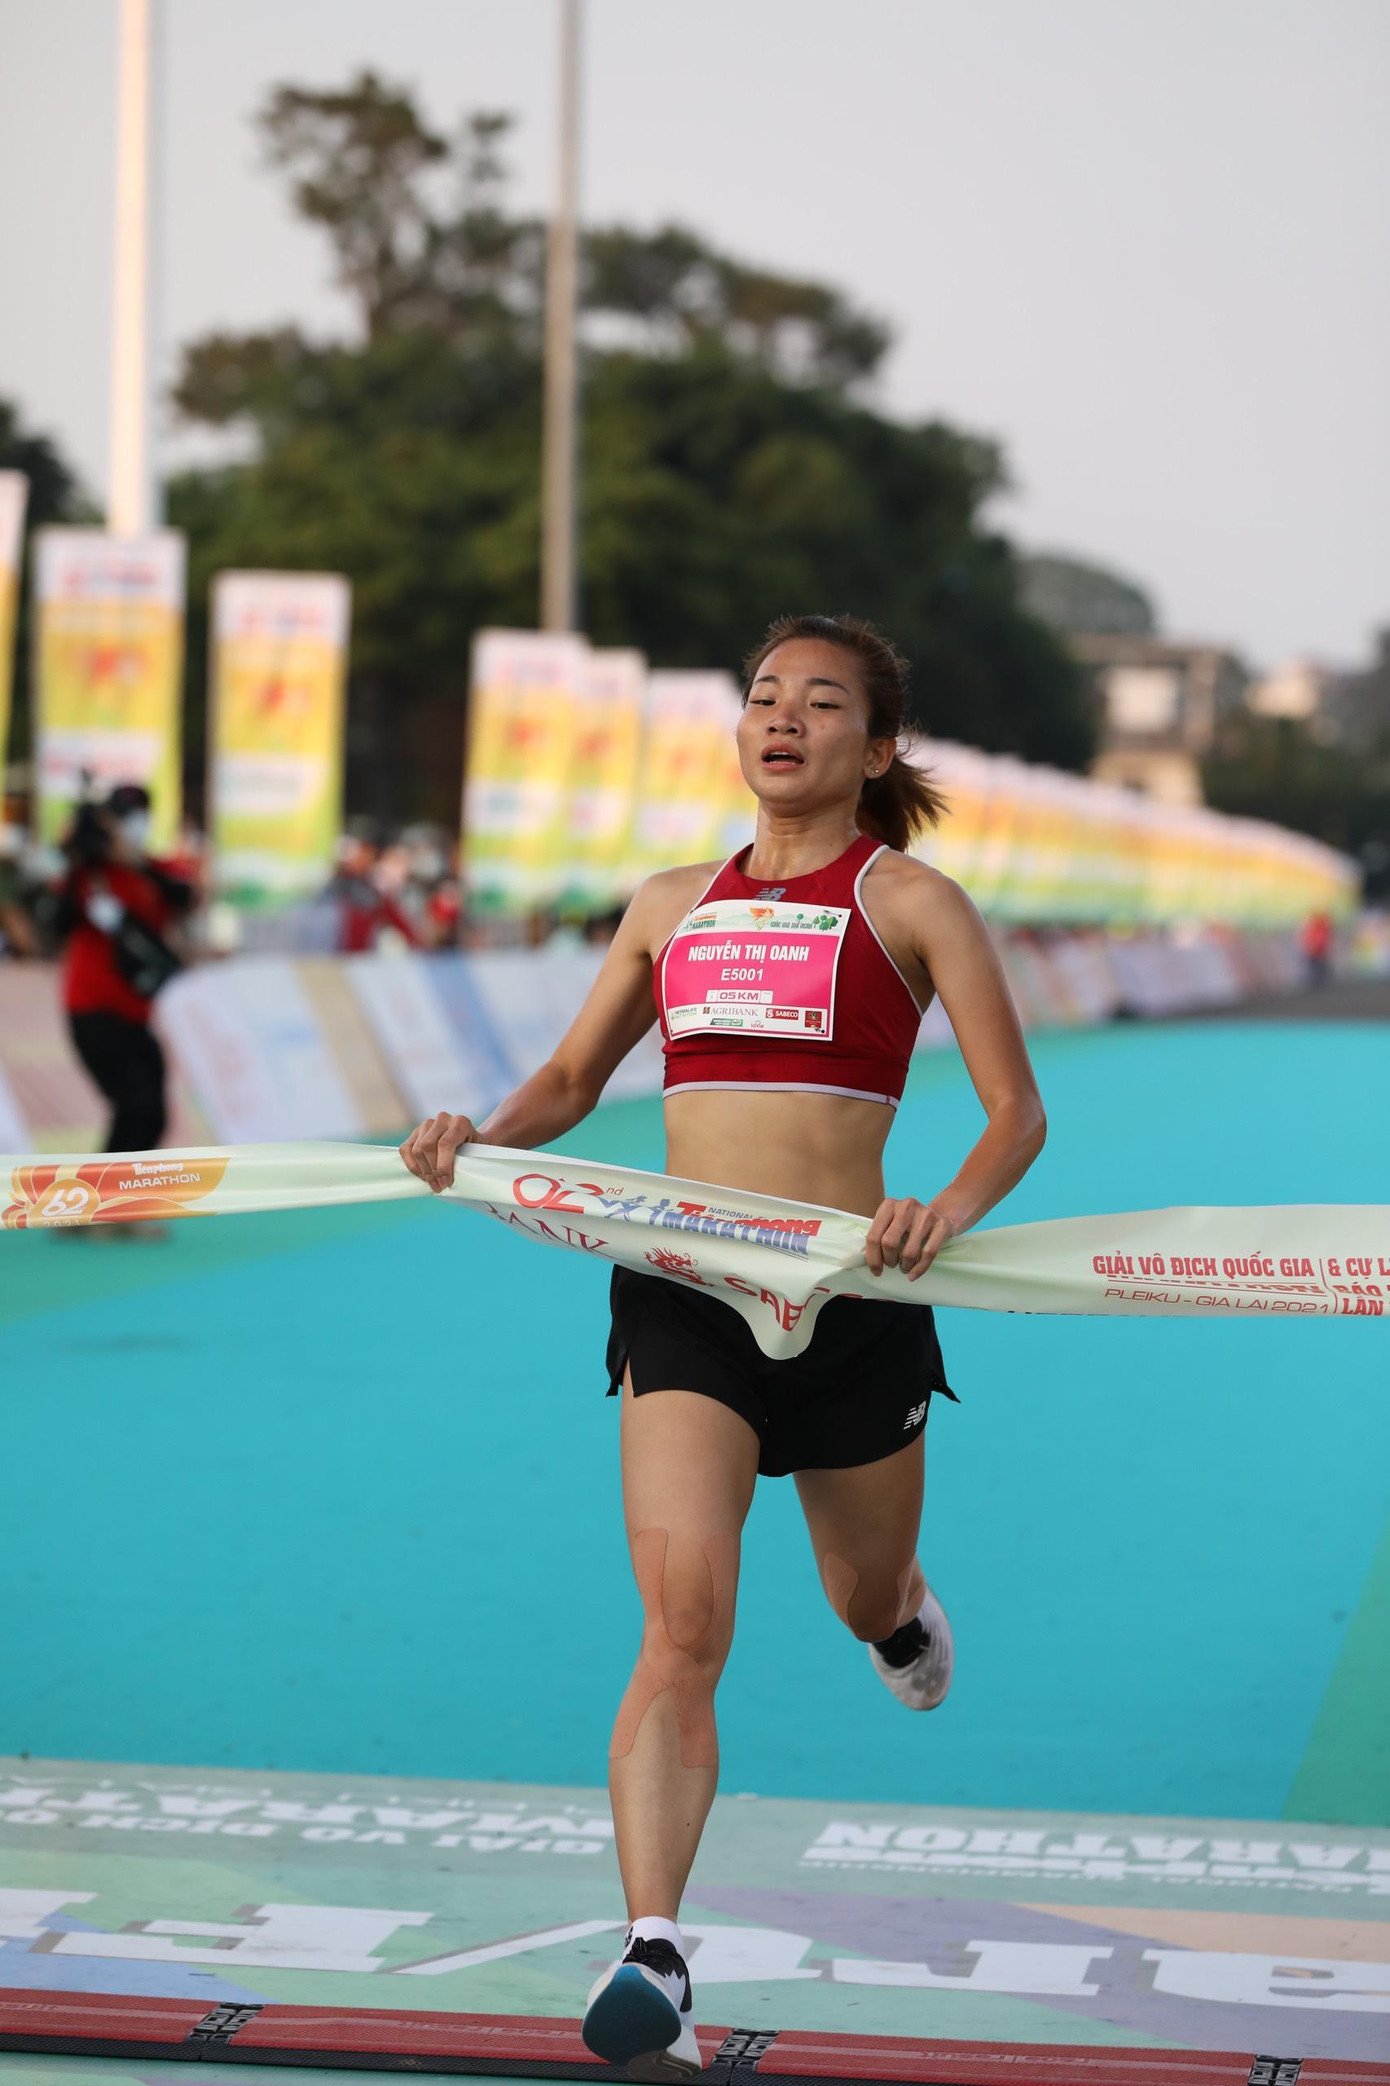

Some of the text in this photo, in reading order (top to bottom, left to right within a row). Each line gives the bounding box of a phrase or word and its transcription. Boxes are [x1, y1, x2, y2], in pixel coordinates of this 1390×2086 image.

[688, 940, 810, 963] NGUYỄN THỊ OANH
[720, 968, 764, 982] E5001
[710, 1007, 759, 1016] AGRIBANK
[775, 1010, 798, 1018] SABECO
[119, 1173, 201, 1191] MARATHON
[42, 1187, 89, 1217] 62
[1093, 1251, 1315, 1279] GIẢI VÔ ĐỊCH QUỐC GIA
[1327, 1257, 1341, 1277] &
[1377, 1257, 1390, 1276] L
[1104, 1288, 1181, 1304] PLEIKU
[1195, 1295, 1231, 1308] GIA
[1235, 1298, 1269, 1310] LAI
[1271, 1300, 1328, 1314] 2021
[811, 1821, 1390, 1871] ARATHON
